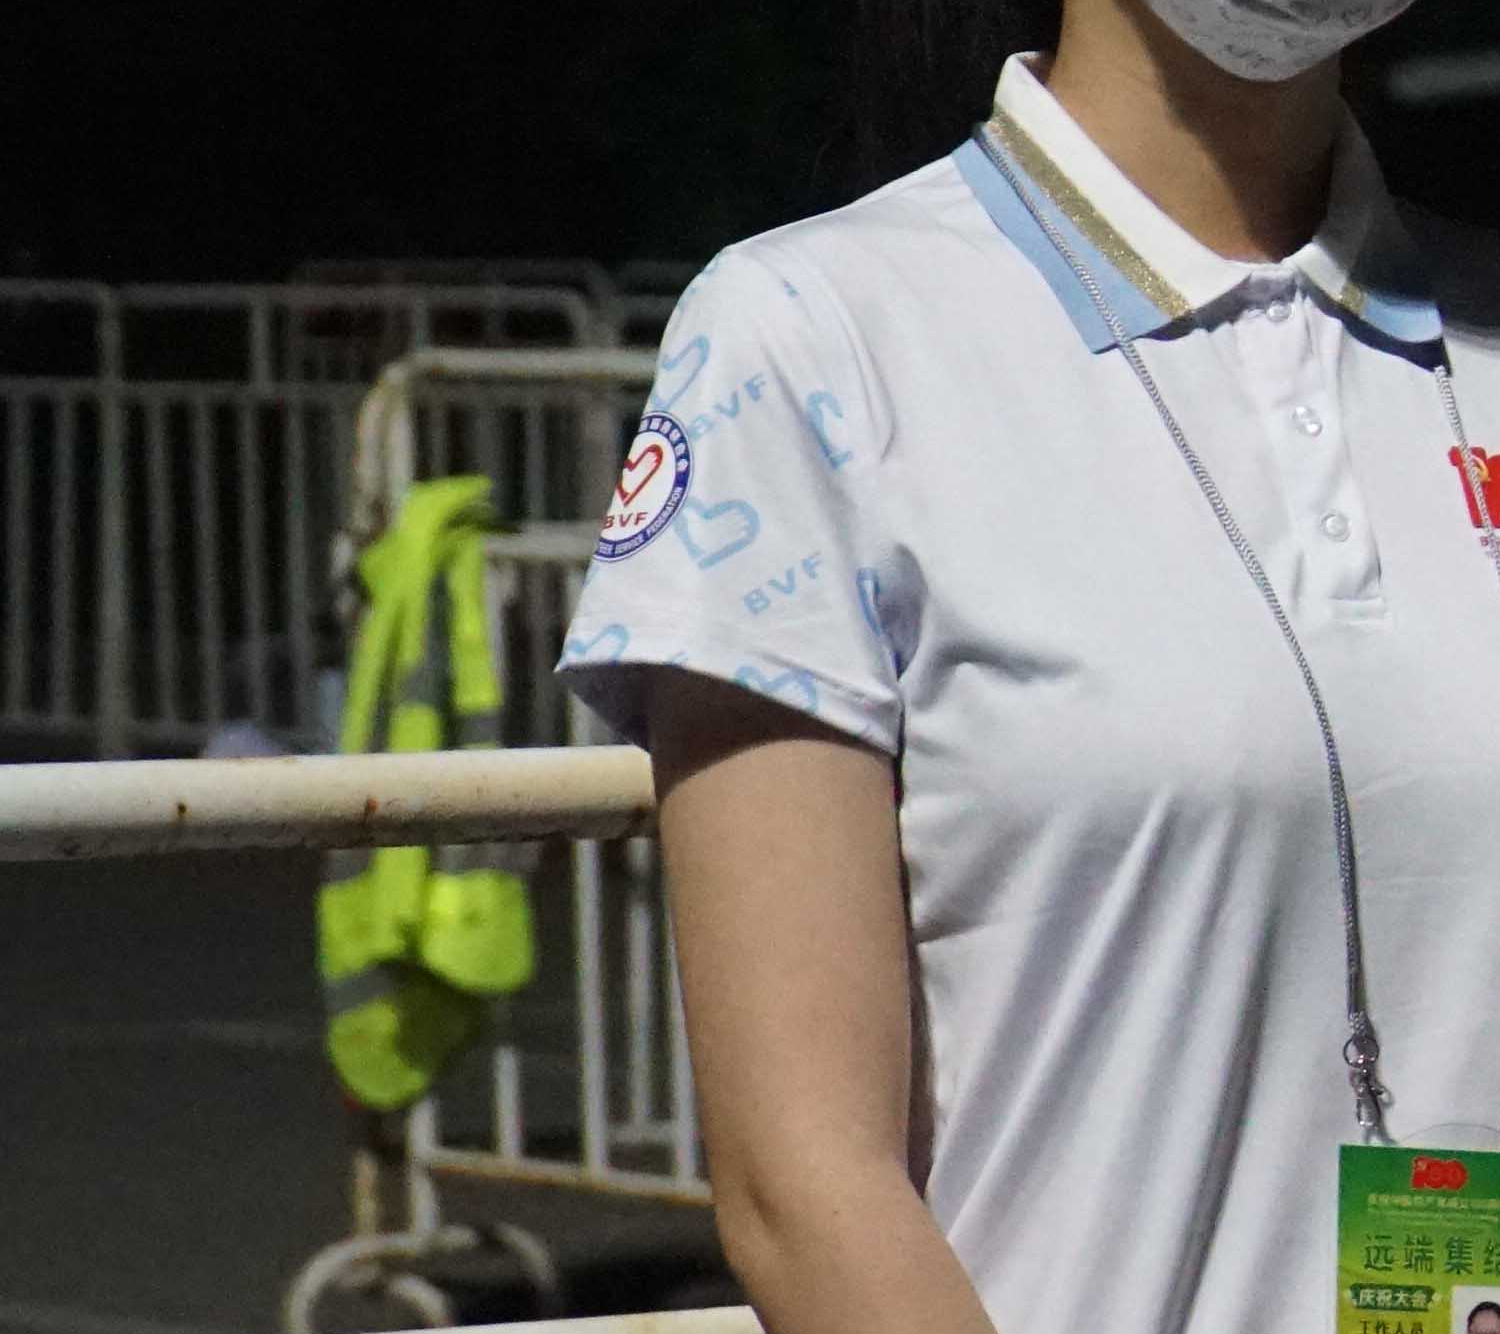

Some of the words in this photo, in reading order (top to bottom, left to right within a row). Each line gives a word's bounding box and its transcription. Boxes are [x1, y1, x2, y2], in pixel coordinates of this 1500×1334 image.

[742, 550, 824, 616] BVF
[1358, 1287, 1429, 1309] 庆祝大会
